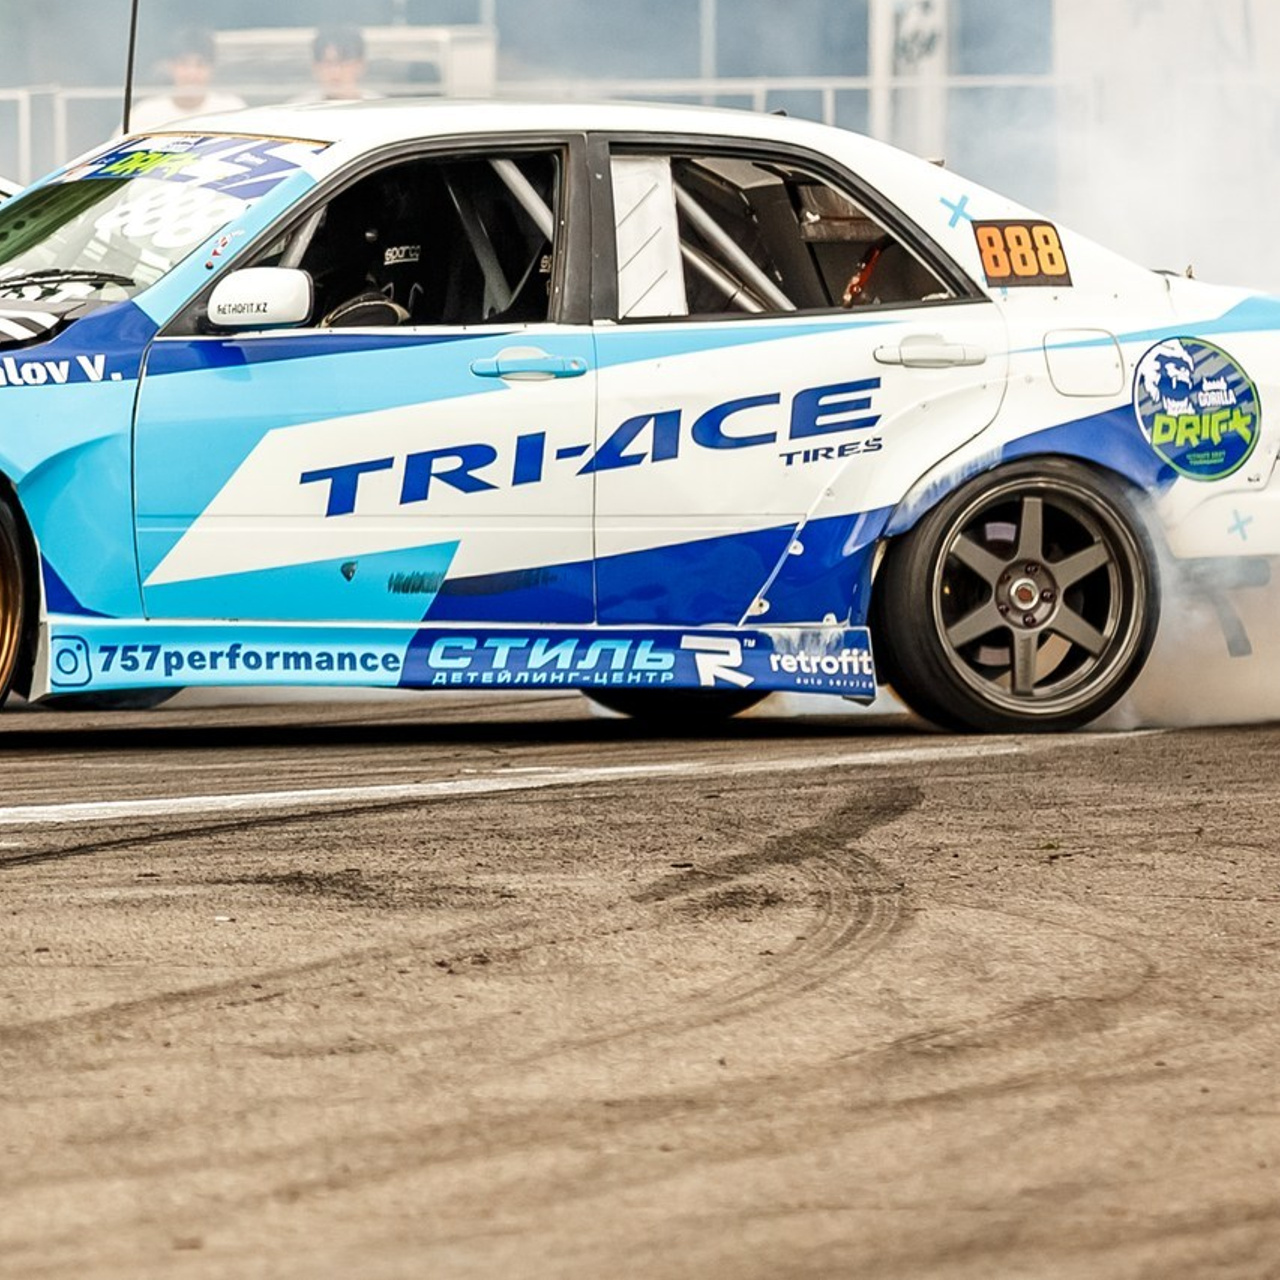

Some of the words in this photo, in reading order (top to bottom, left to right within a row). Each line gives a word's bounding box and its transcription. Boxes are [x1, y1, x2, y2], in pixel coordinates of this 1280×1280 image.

[976, 226, 1067, 277] 888
[76, 354, 123, 382] V.
[299, 377, 882, 518] TRI-ACE
[779, 437, 883, 467] TIRES
[98, 643, 401, 677] 757performance
[427, 636, 676, 670] СТИЛЬ
[770, 648, 875, 676] retrofit
[431, 670, 675, 686] ДЕТЕЙЛИНГ-ЦЕНТР
